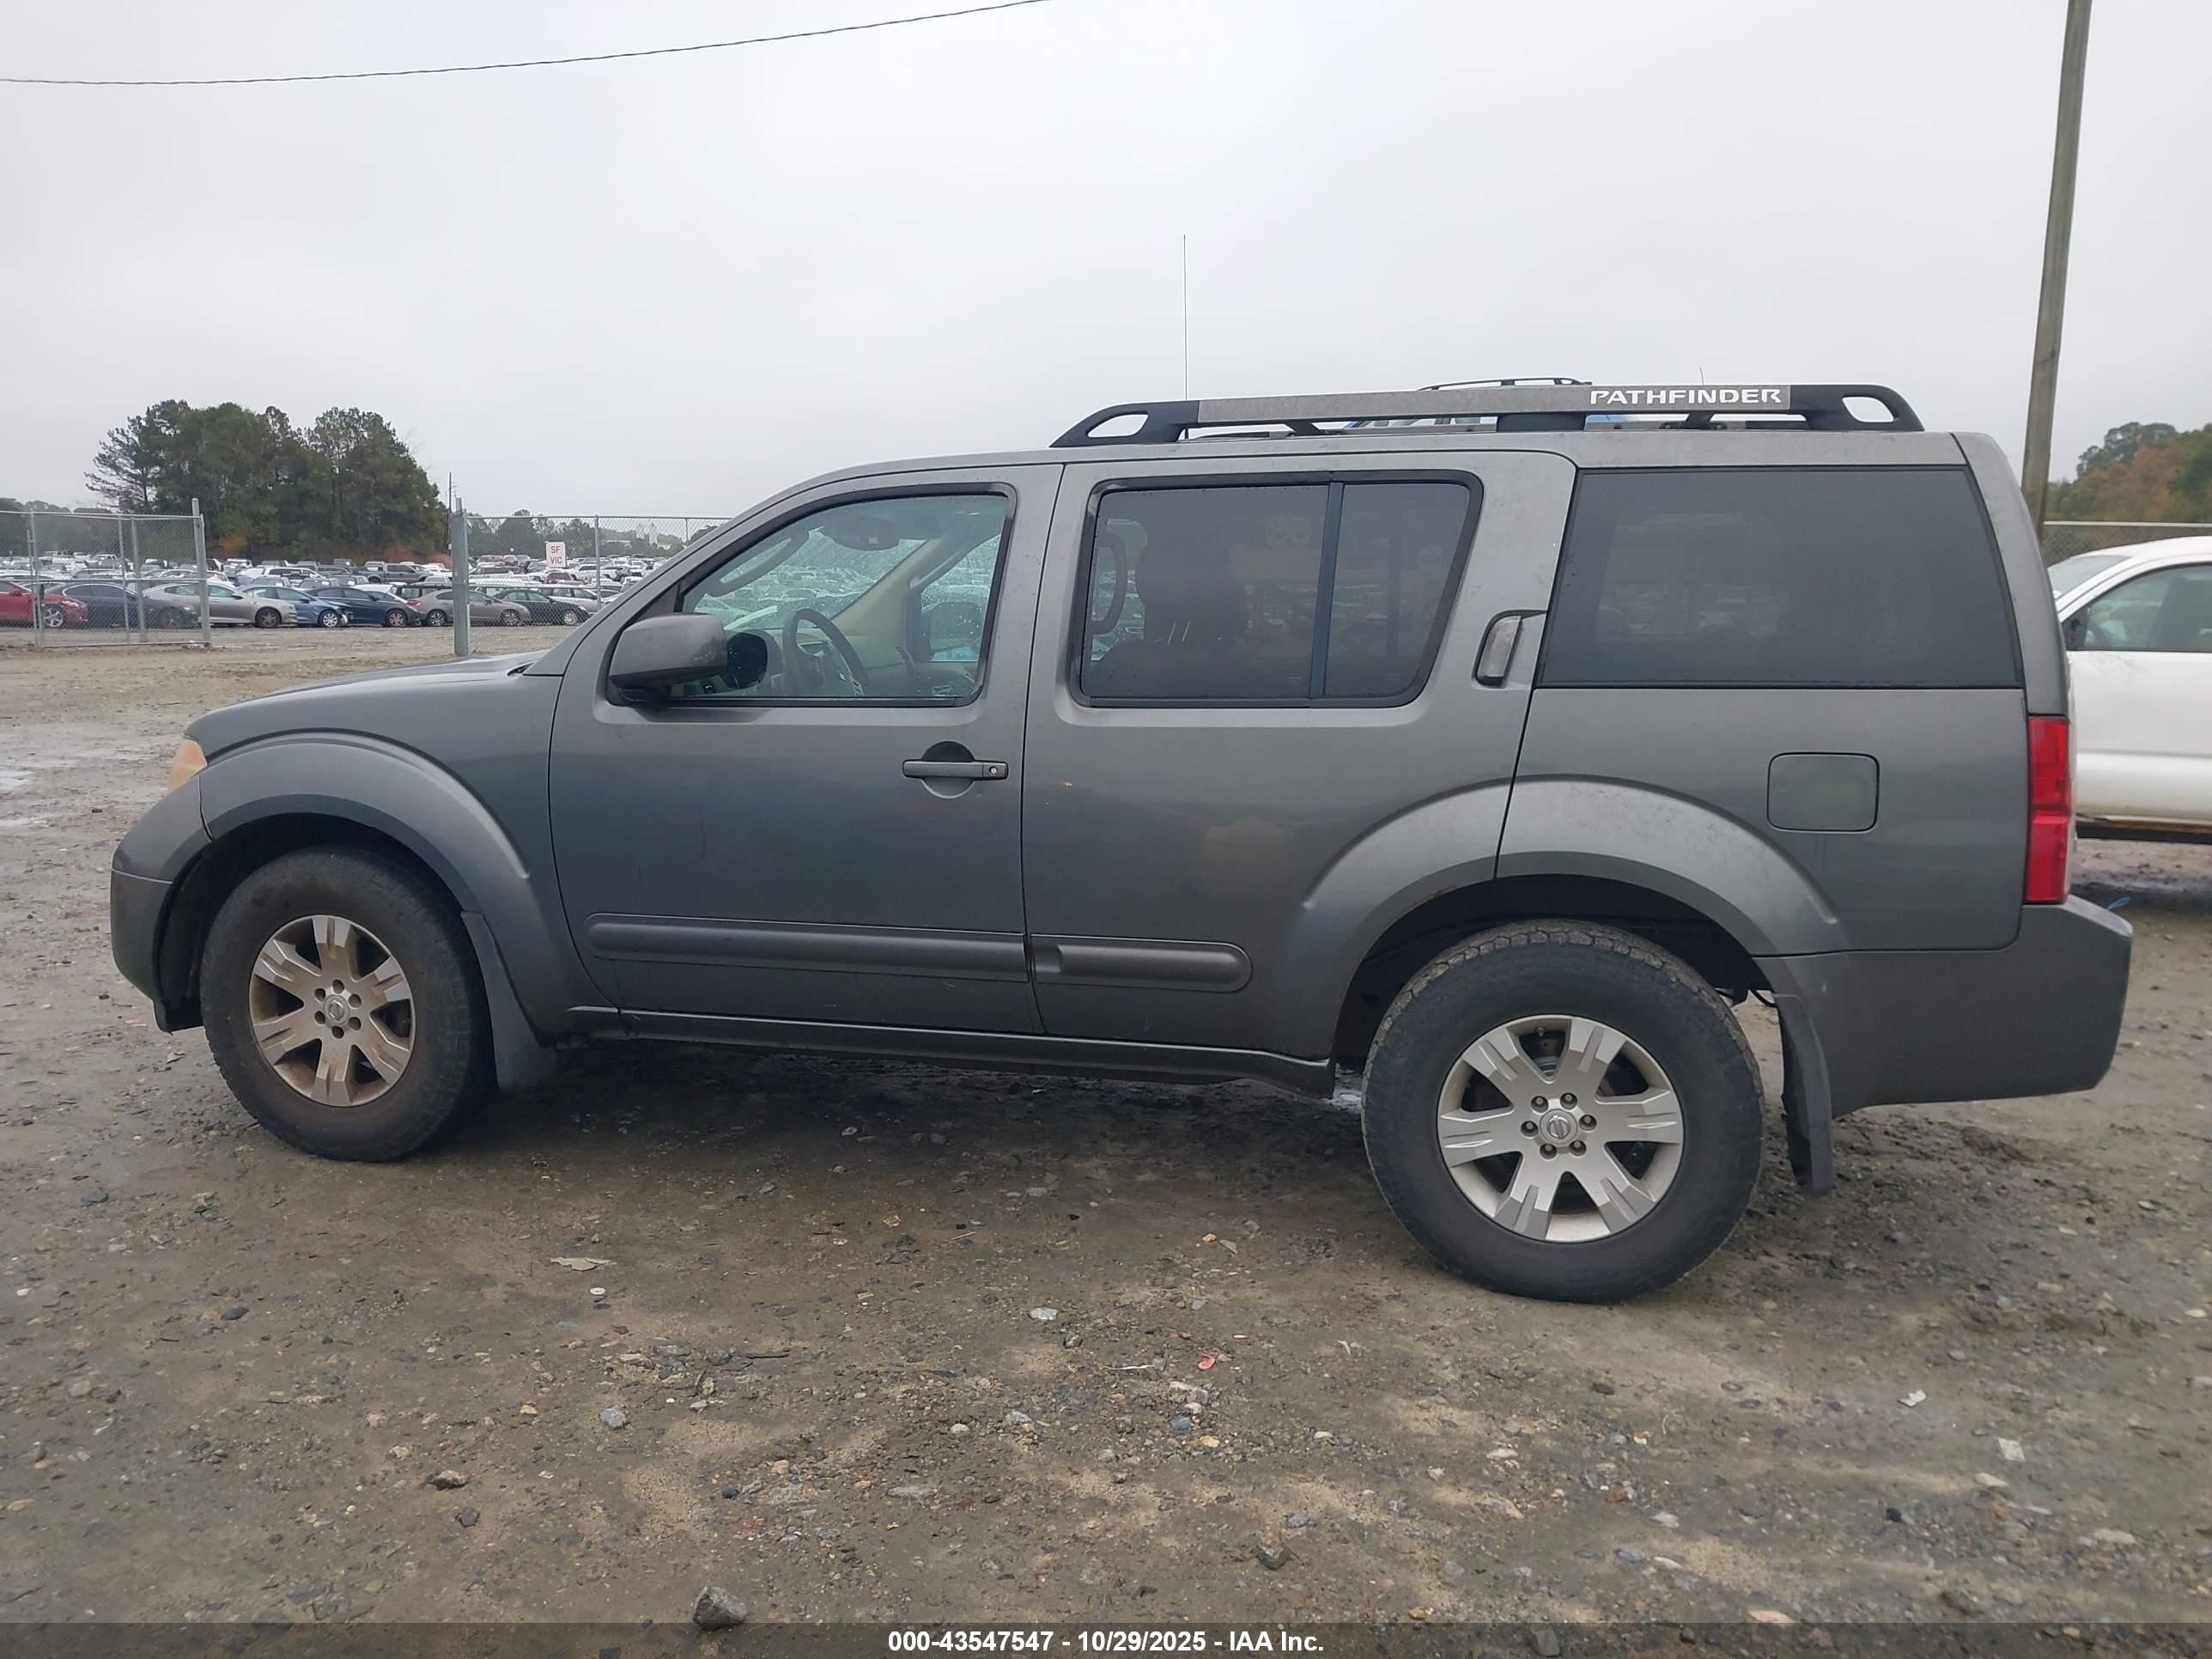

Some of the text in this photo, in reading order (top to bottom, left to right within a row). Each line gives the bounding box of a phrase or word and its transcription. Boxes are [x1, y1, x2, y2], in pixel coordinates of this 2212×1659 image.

[1589, 388, 1782, 405] PATHFINDER
[550, 545, 561, 554] SF
[550, 556, 562, 564] VIC
